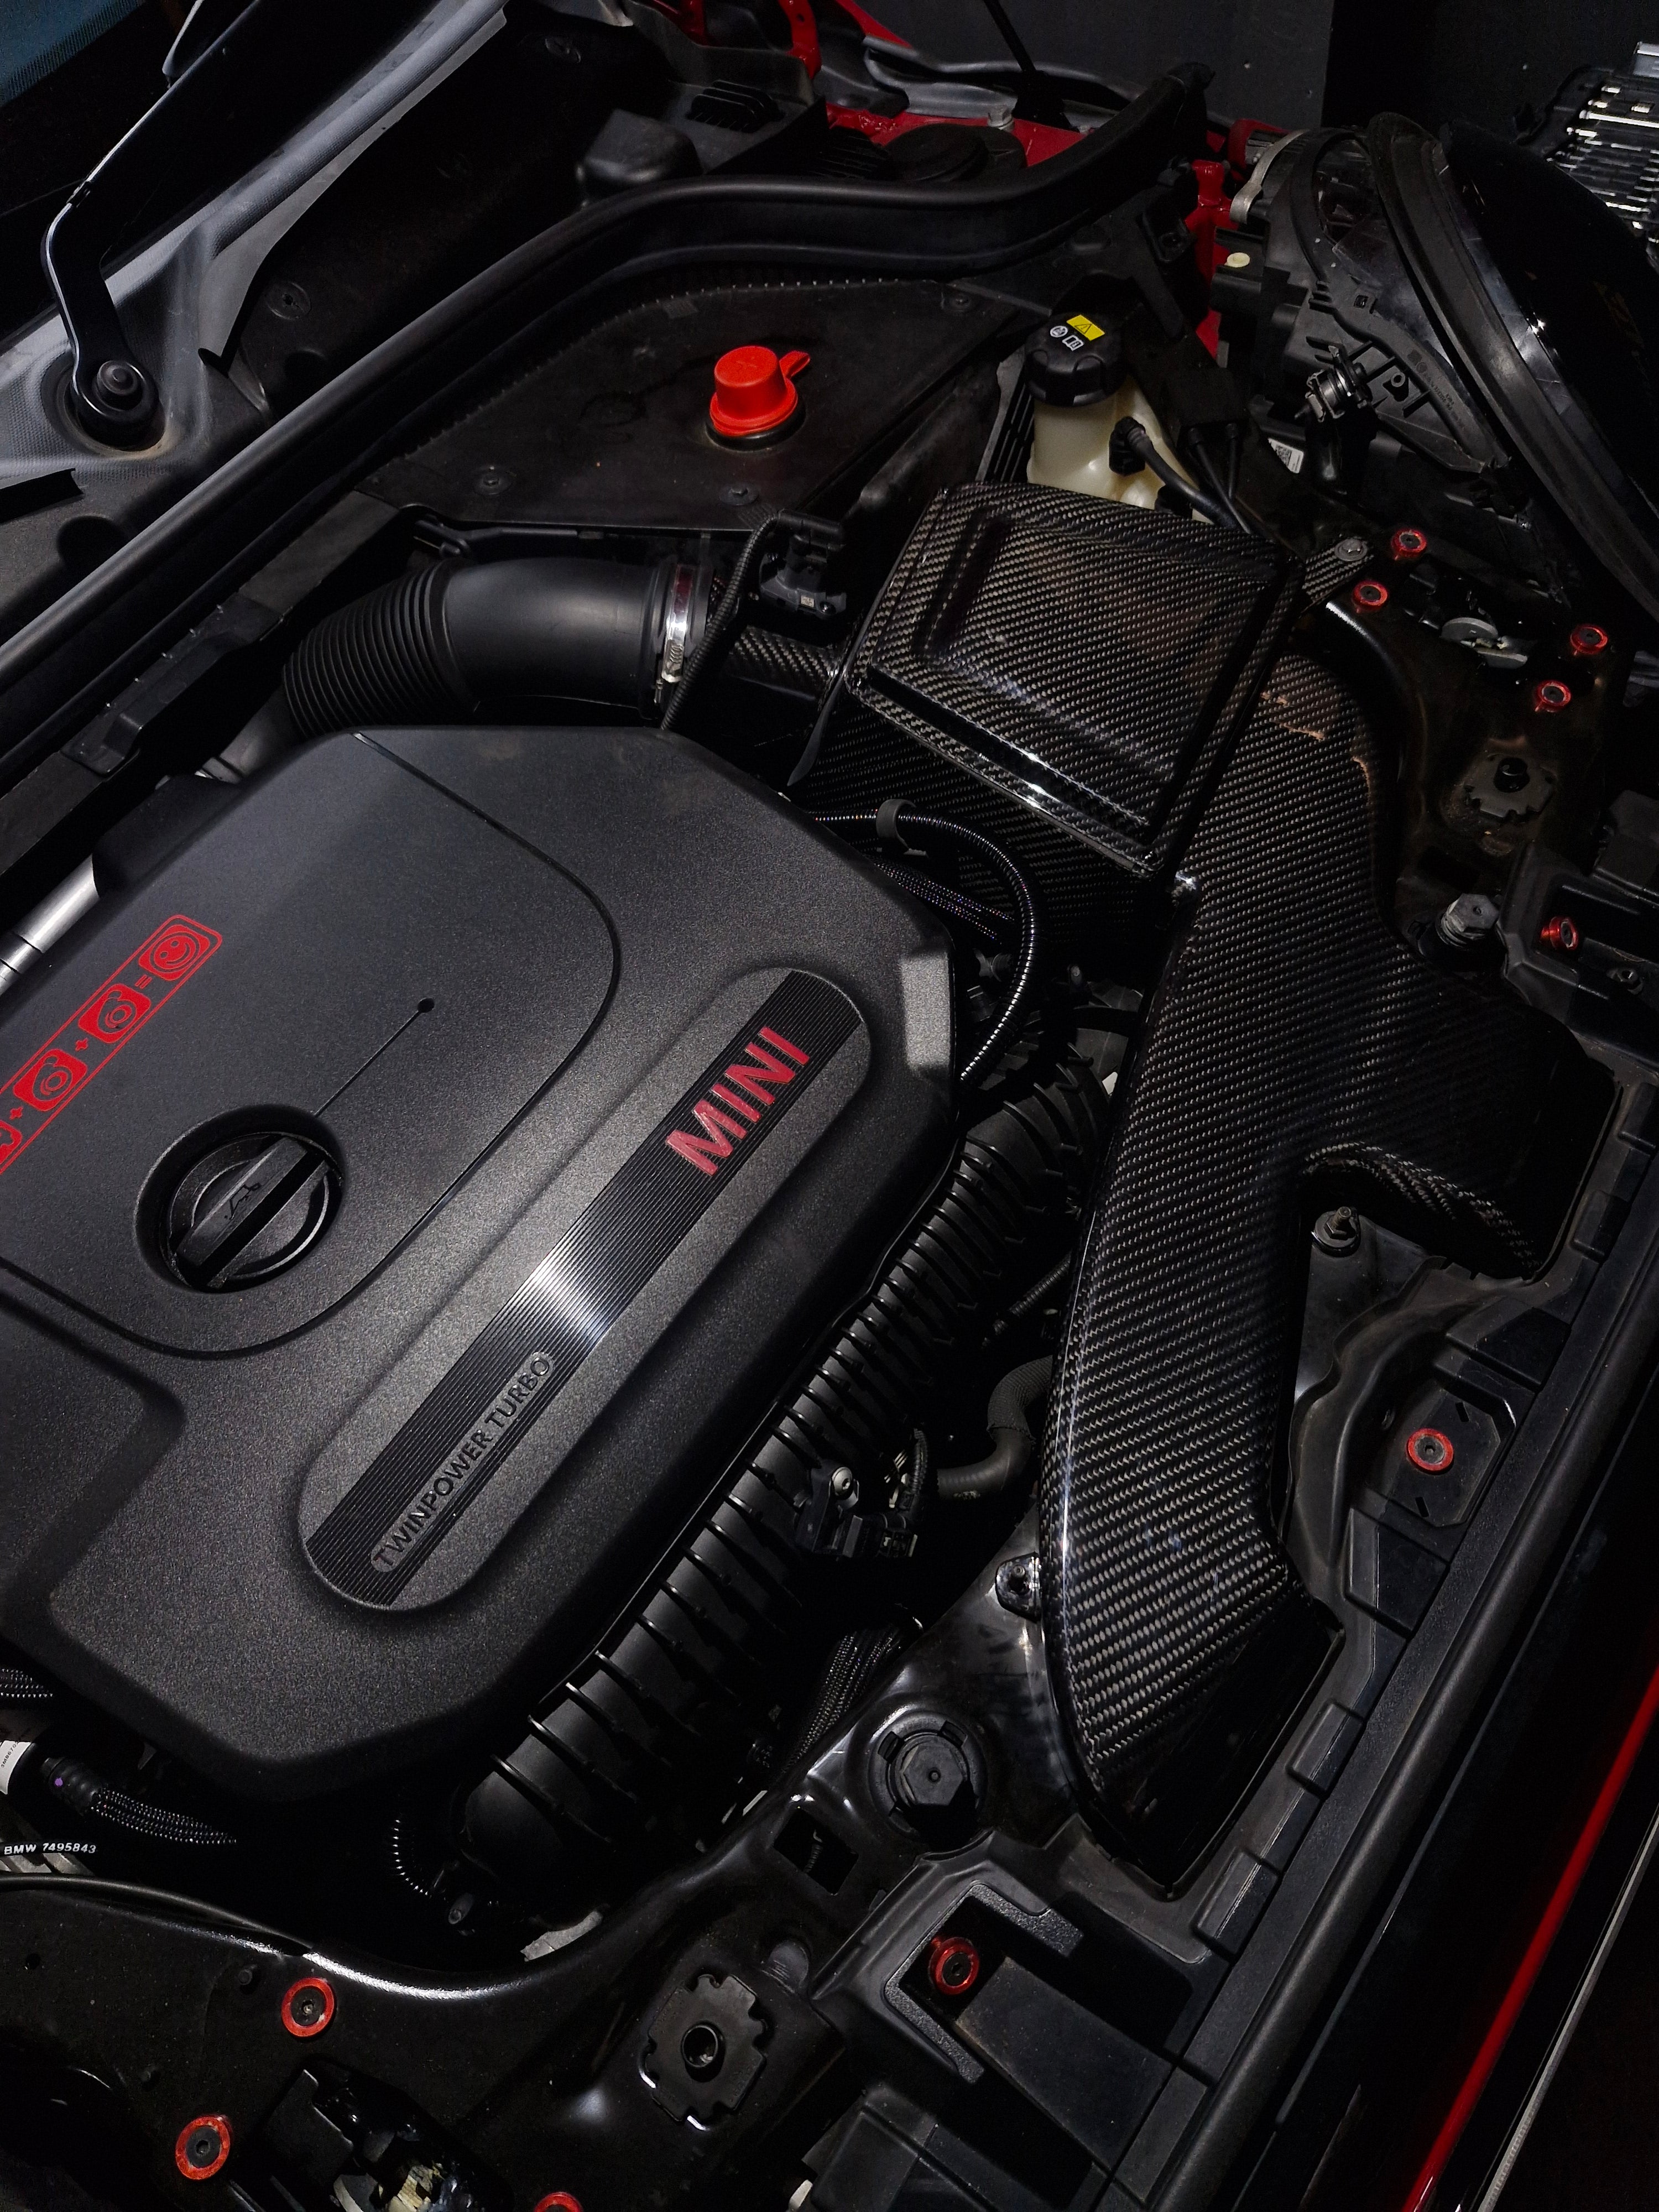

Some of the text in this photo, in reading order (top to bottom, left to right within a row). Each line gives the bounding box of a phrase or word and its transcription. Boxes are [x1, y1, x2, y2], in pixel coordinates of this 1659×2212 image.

[666, 1026, 810, 1176] MINI
[373, 1357, 550, 1566] TWINPOWER TURBO
[4, 1842, 97, 1855] BMW 7495843
